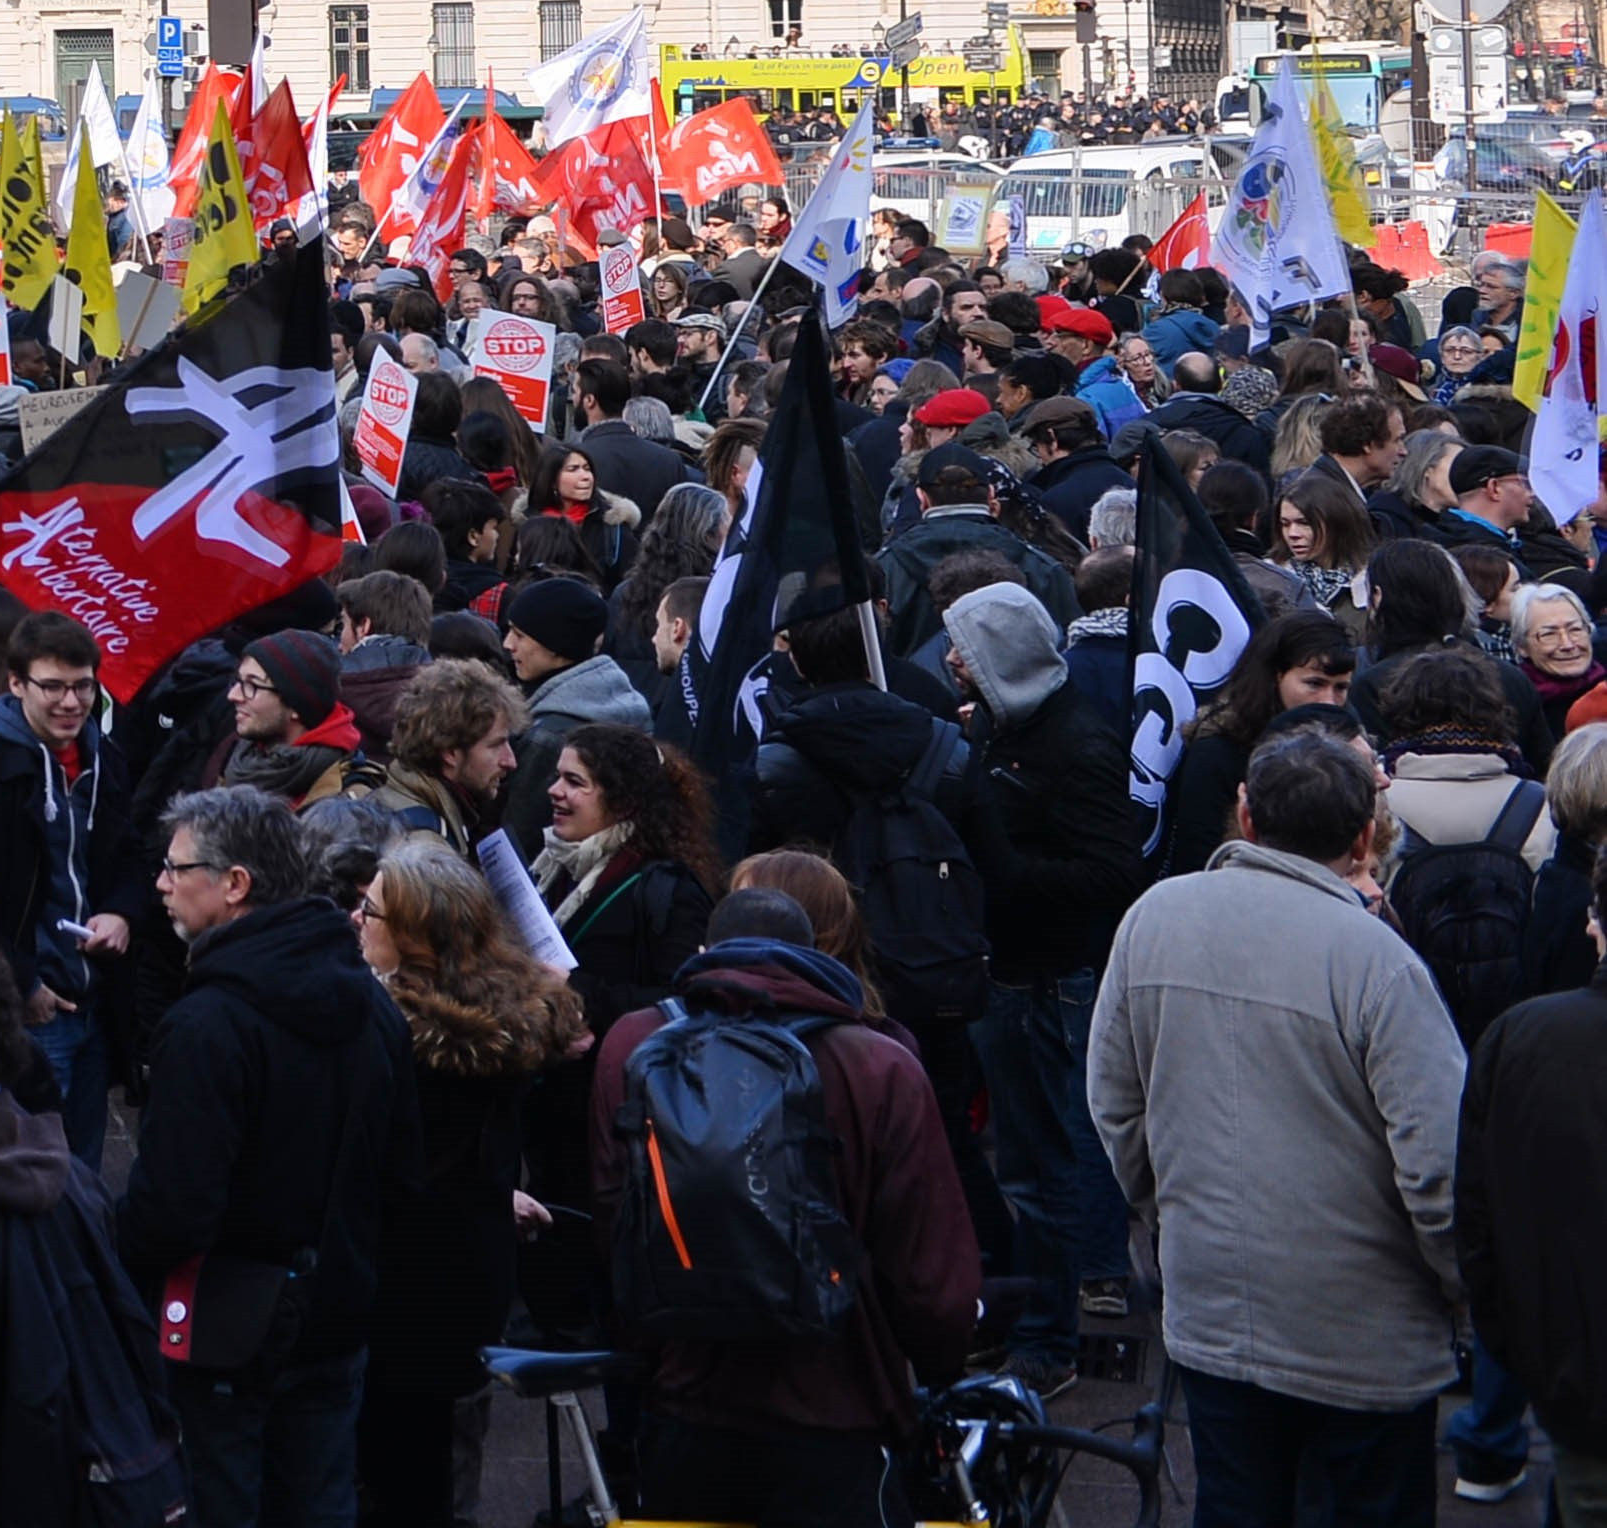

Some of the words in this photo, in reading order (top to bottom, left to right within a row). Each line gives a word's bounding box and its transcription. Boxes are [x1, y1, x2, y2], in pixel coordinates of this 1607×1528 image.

[607, 259, 634, 284] STOP
[485, 337, 544, 354] STOP
[371, 381, 408, 408] STOP
[2, 496, 159, 623] Alternative
